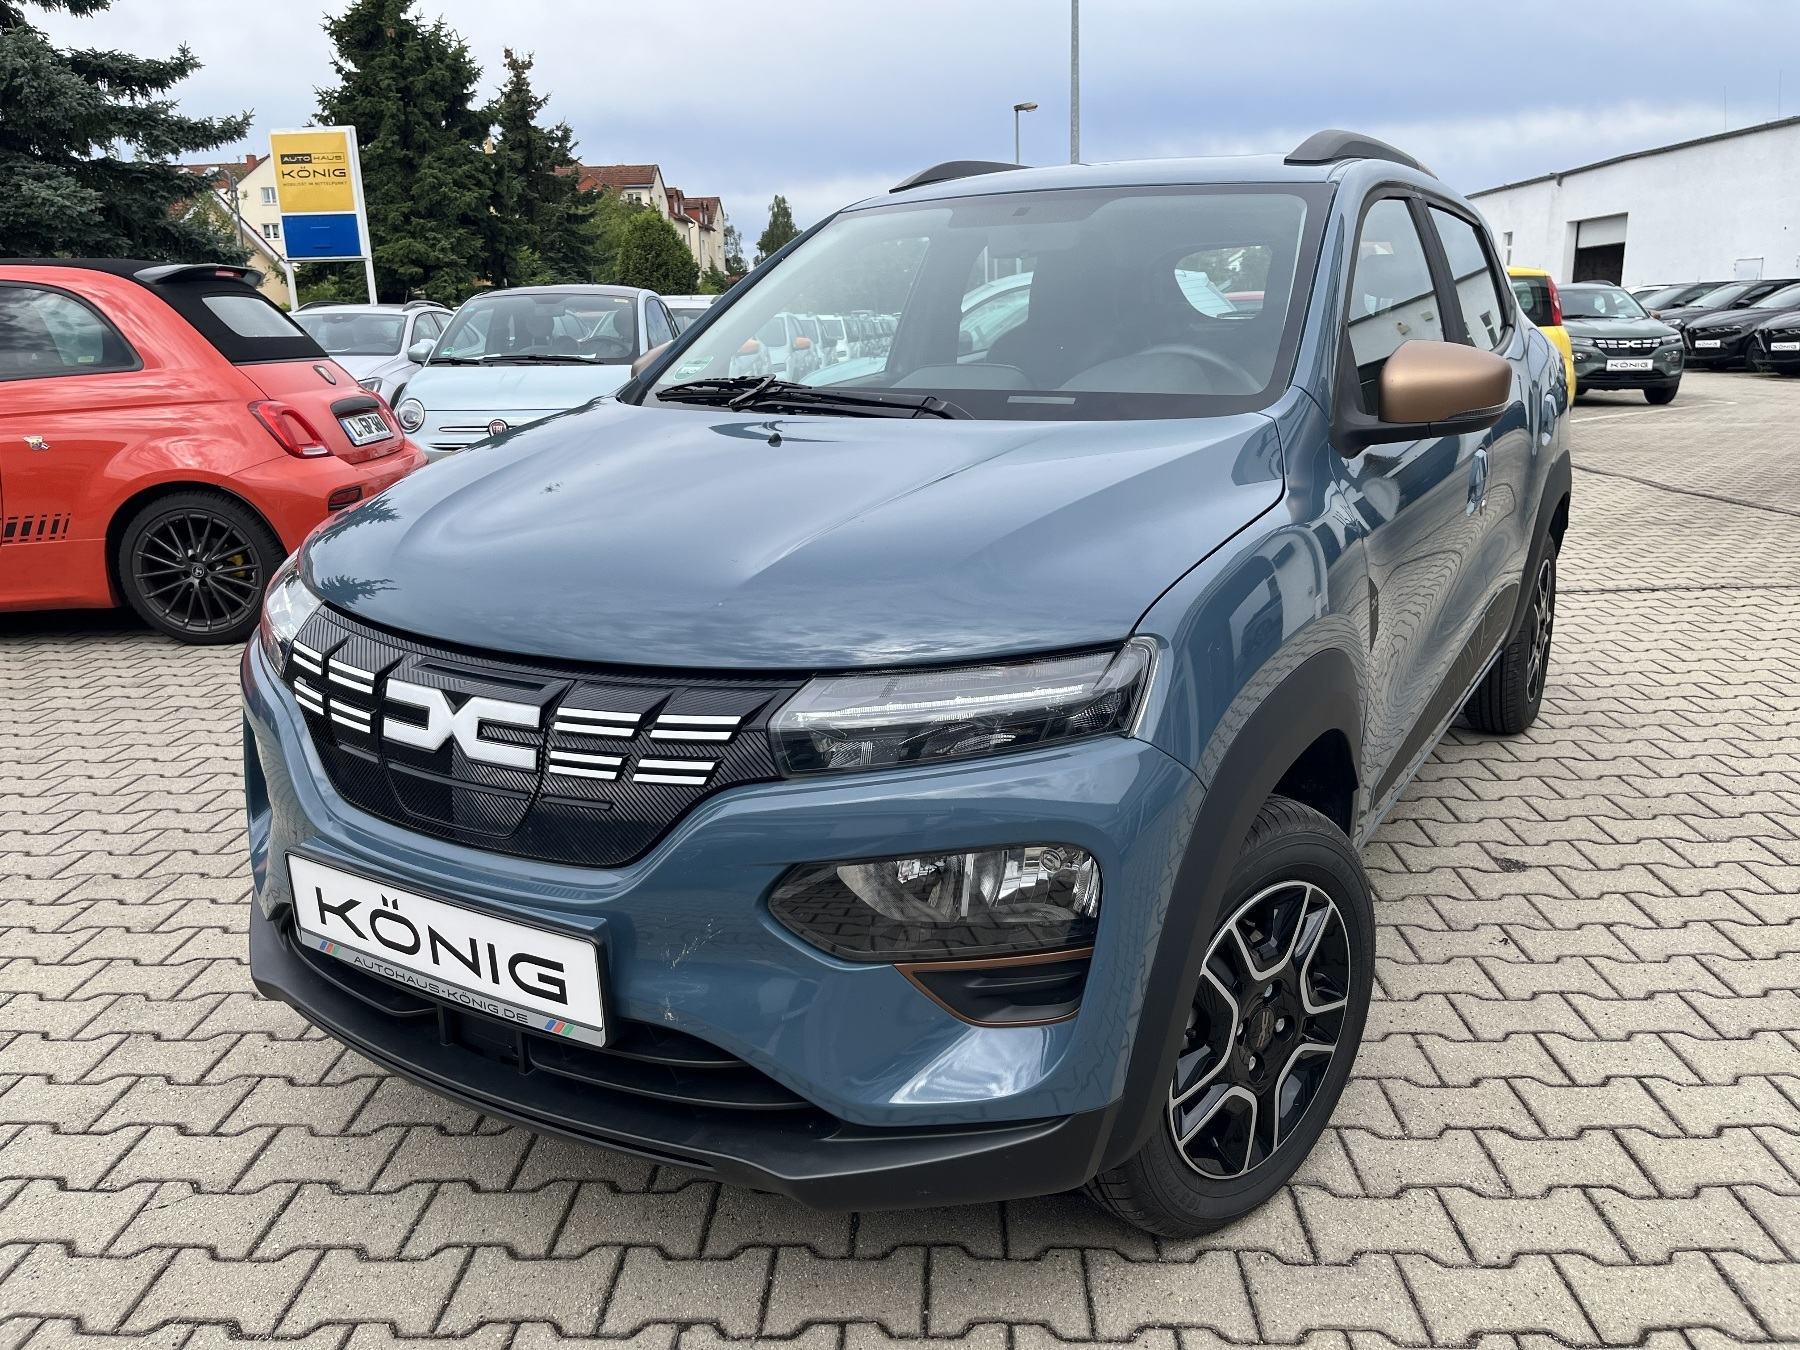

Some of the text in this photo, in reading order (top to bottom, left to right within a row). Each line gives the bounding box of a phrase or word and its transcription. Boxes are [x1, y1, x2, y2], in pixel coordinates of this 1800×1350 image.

[281, 166, 347, 179] KÖNIG
[315, 886, 568, 1006] KÖNIG
[353, 955, 529, 1024] AUTOHAUS-KÖNIG.DE
